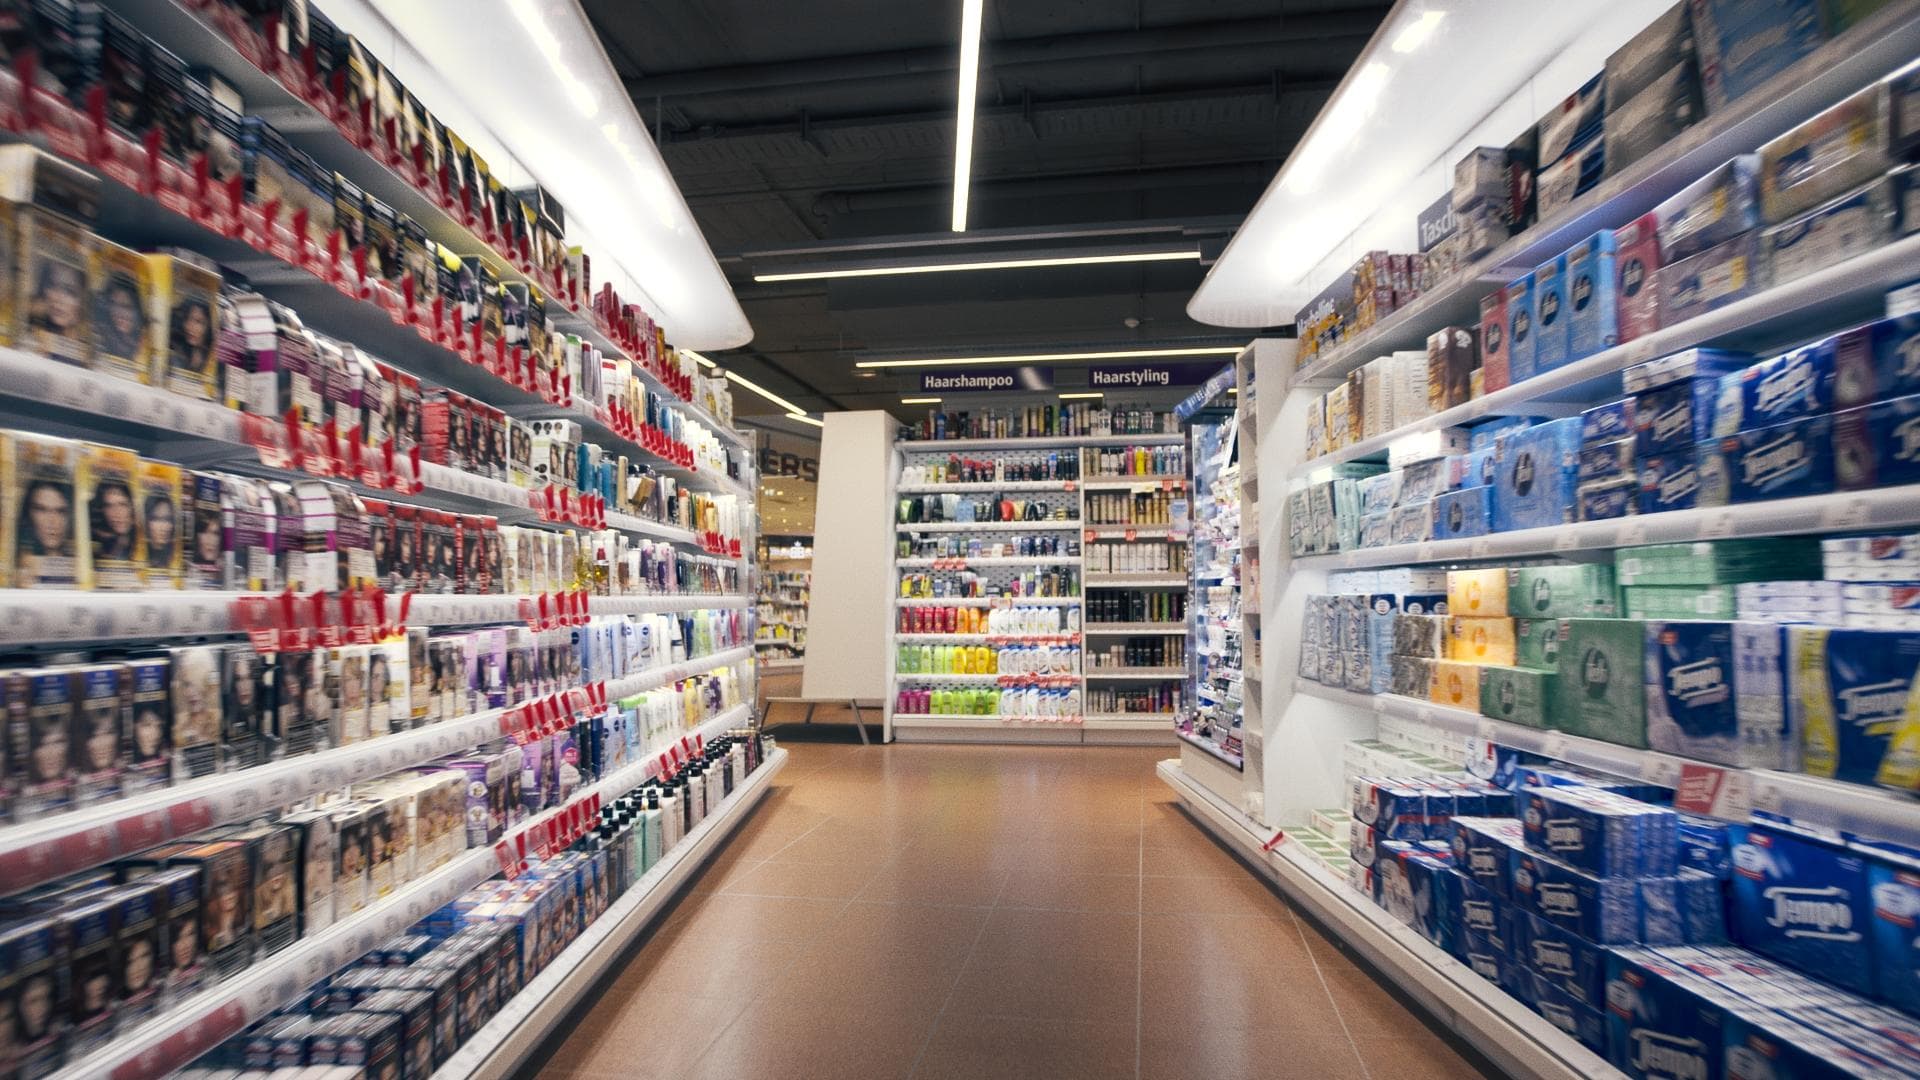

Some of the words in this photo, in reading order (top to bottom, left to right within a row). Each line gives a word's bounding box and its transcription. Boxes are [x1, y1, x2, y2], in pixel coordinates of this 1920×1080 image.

[924, 373, 1014, 389] Haarshampoo
[1093, 368, 1170, 384] Haarstyling
[1763, 885, 1863, 942] Tempo
